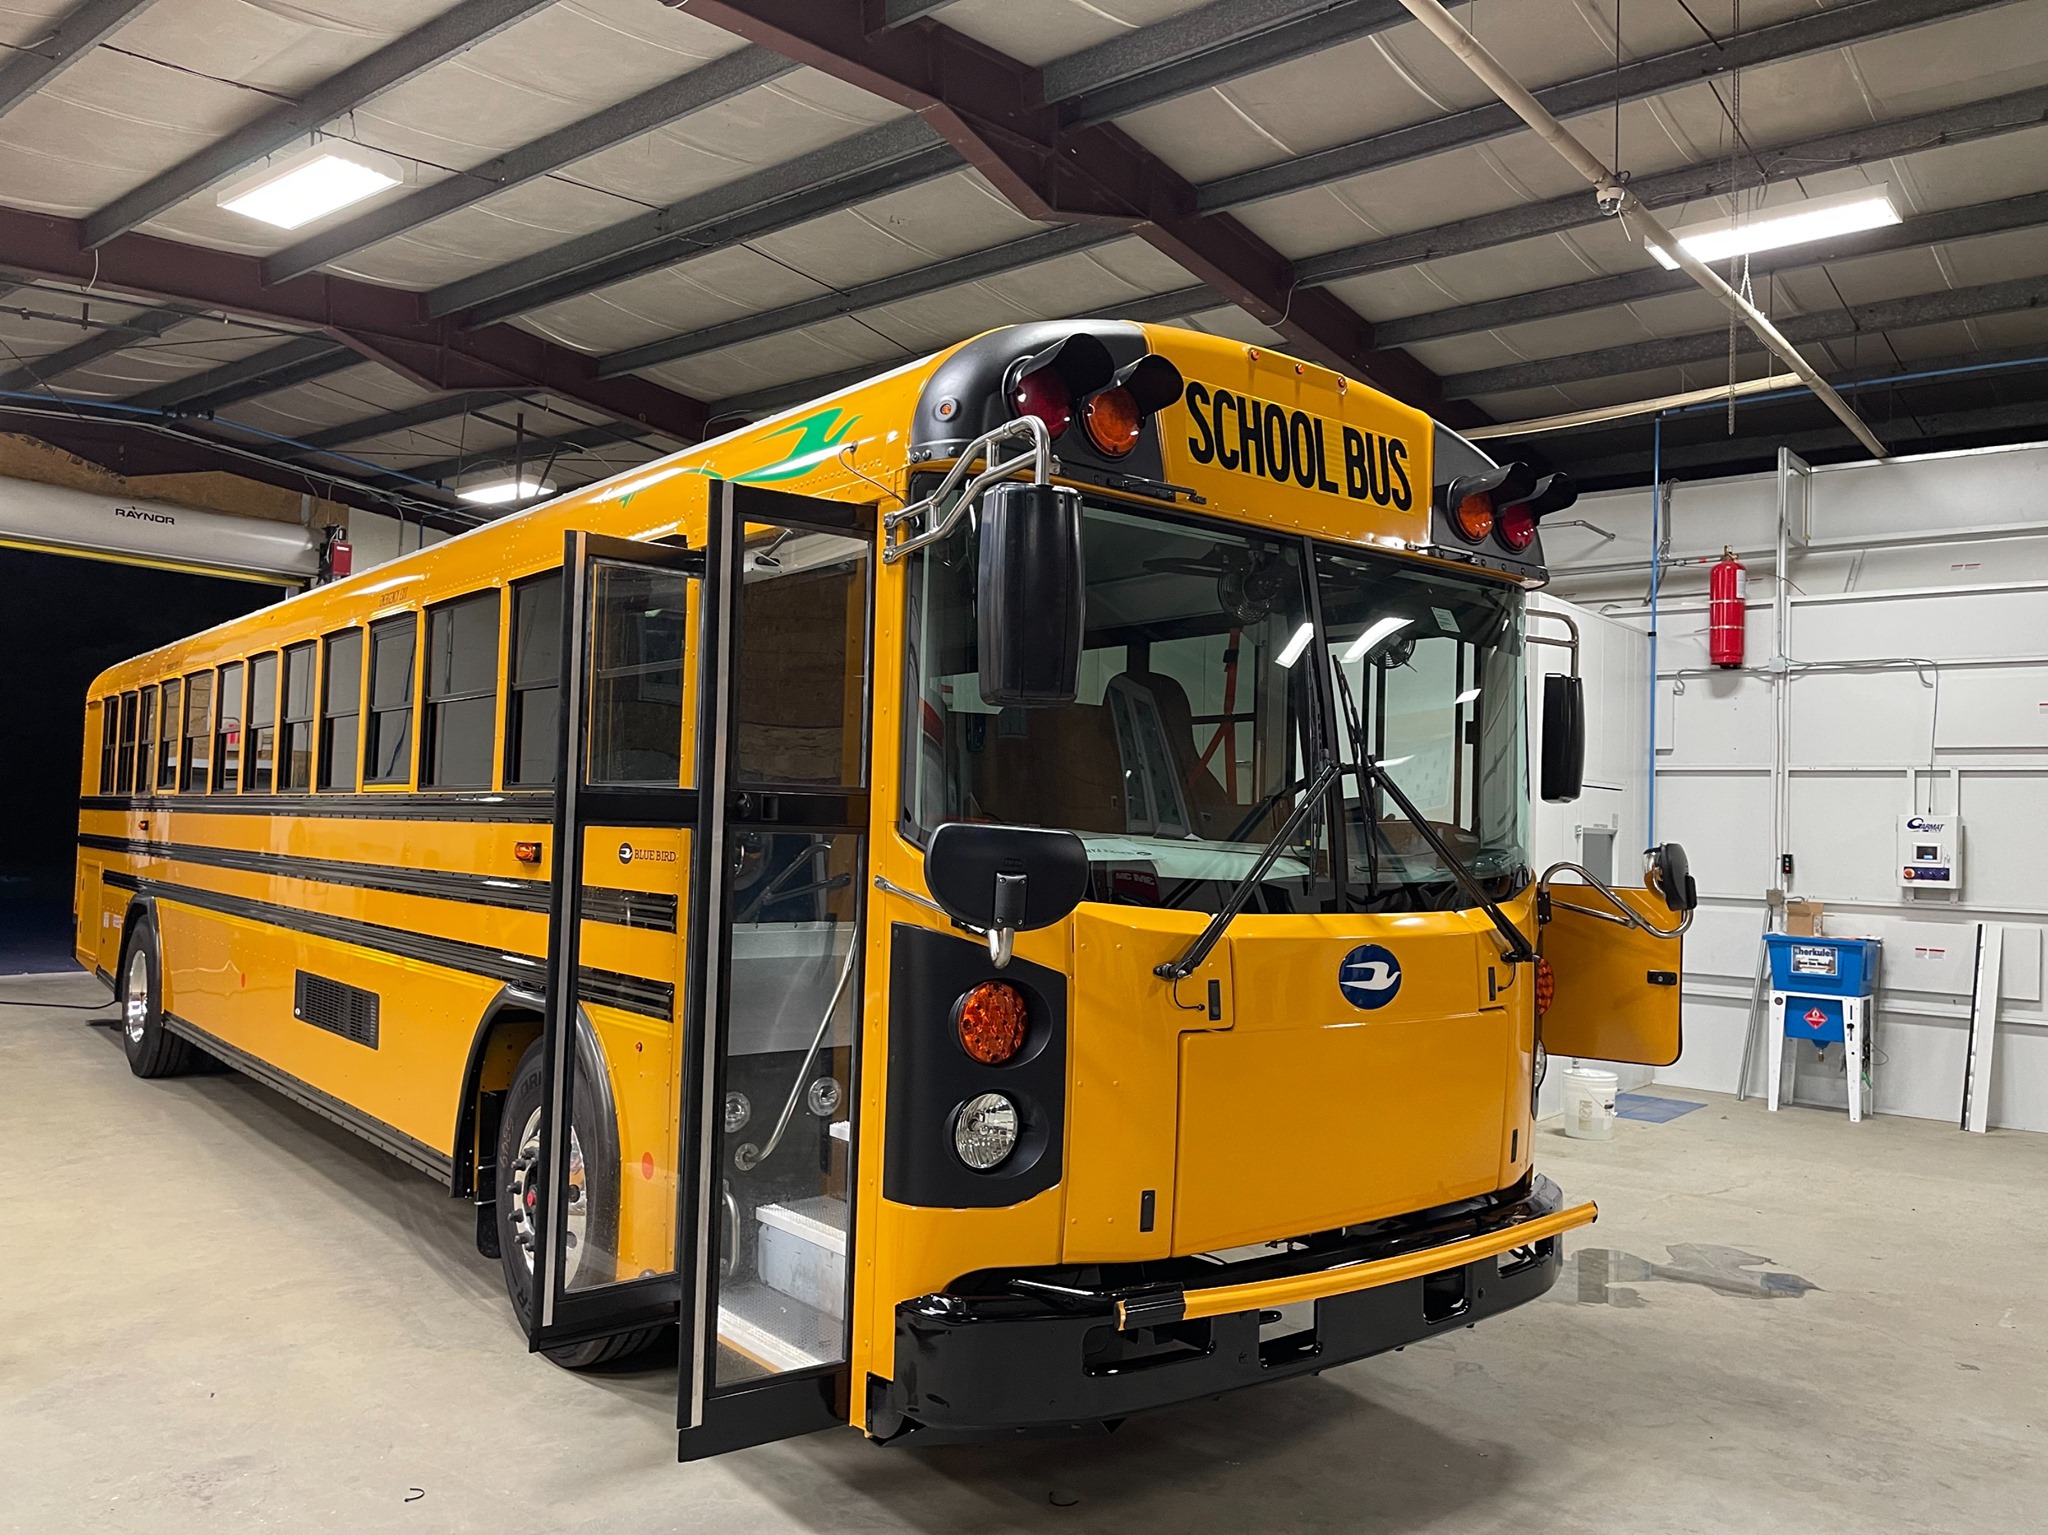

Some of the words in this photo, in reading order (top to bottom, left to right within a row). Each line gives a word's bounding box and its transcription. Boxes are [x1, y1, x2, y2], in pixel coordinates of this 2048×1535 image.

[1185, 381, 1339, 495] SCHOOL
[1342, 425, 1412, 512] BUS
[115, 507, 175, 525] RAYNOR
[634, 849, 655, 861] BLUE
[655, 850, 677, 862] BIRD
